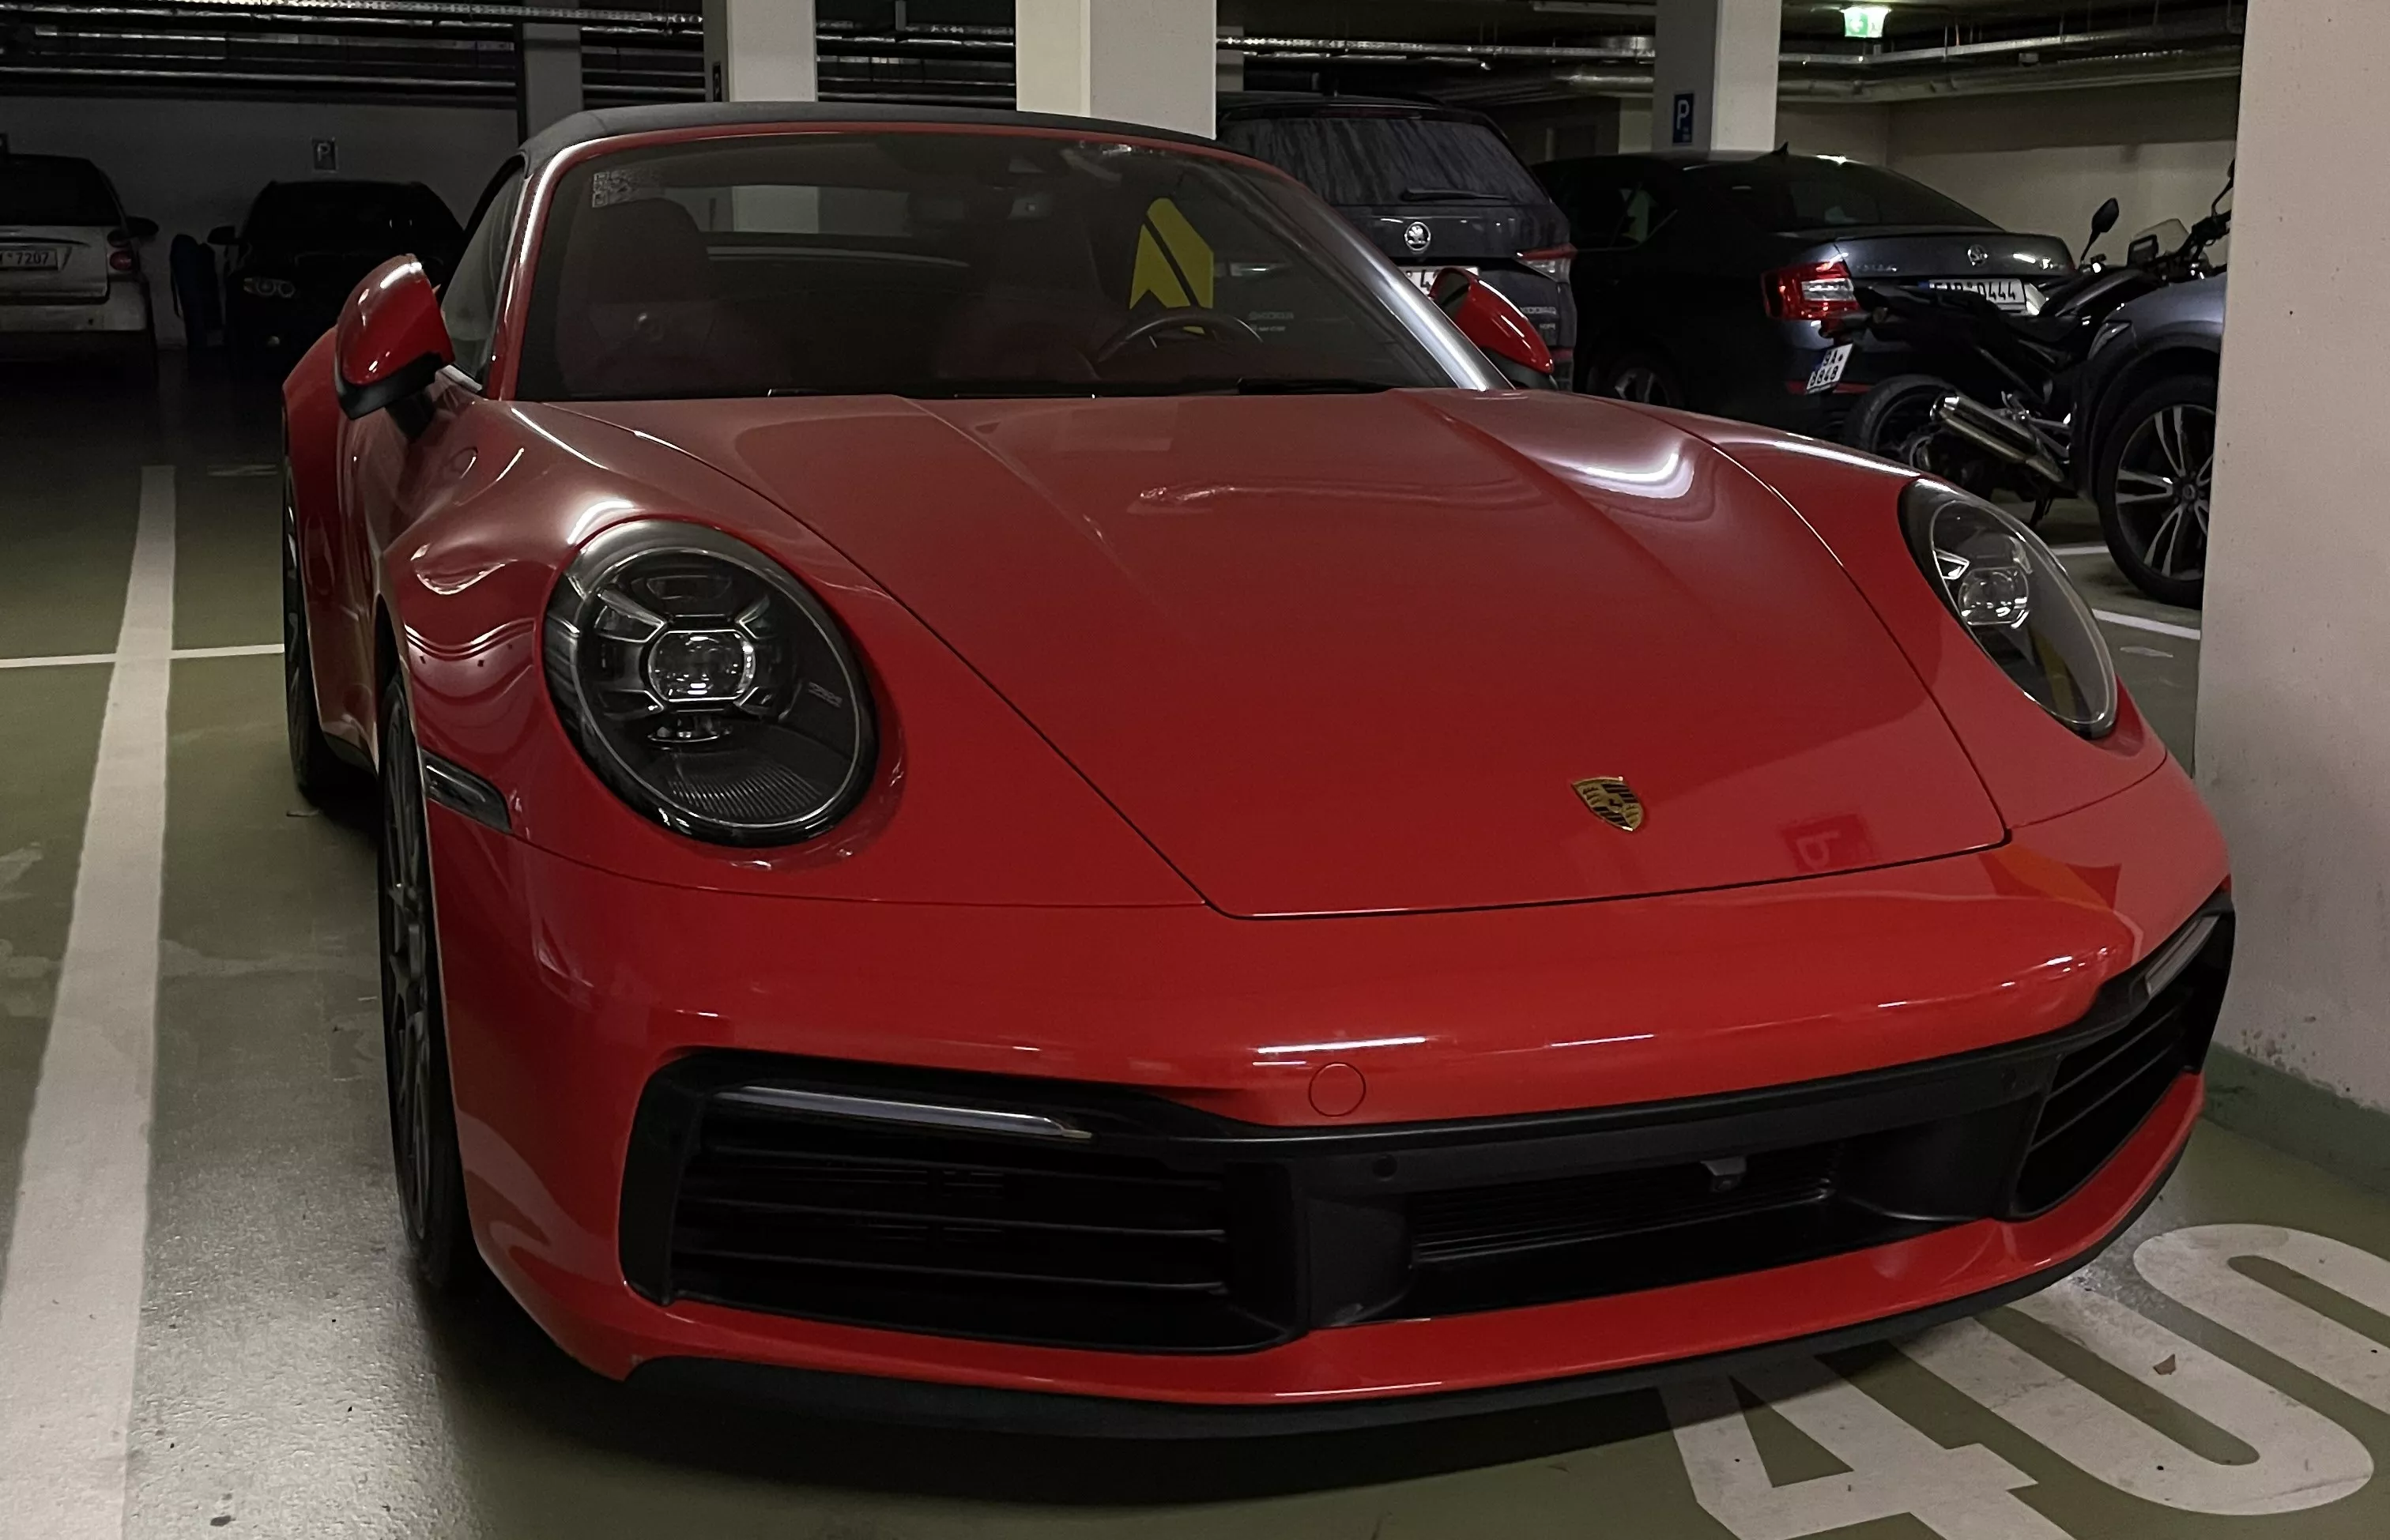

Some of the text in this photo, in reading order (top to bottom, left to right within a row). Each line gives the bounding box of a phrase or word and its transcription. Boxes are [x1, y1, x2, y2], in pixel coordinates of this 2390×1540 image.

[1676, 99, 1691, 130] P
[317, 142, 331, 162] P
[16, 252, 49, 265] 7207
